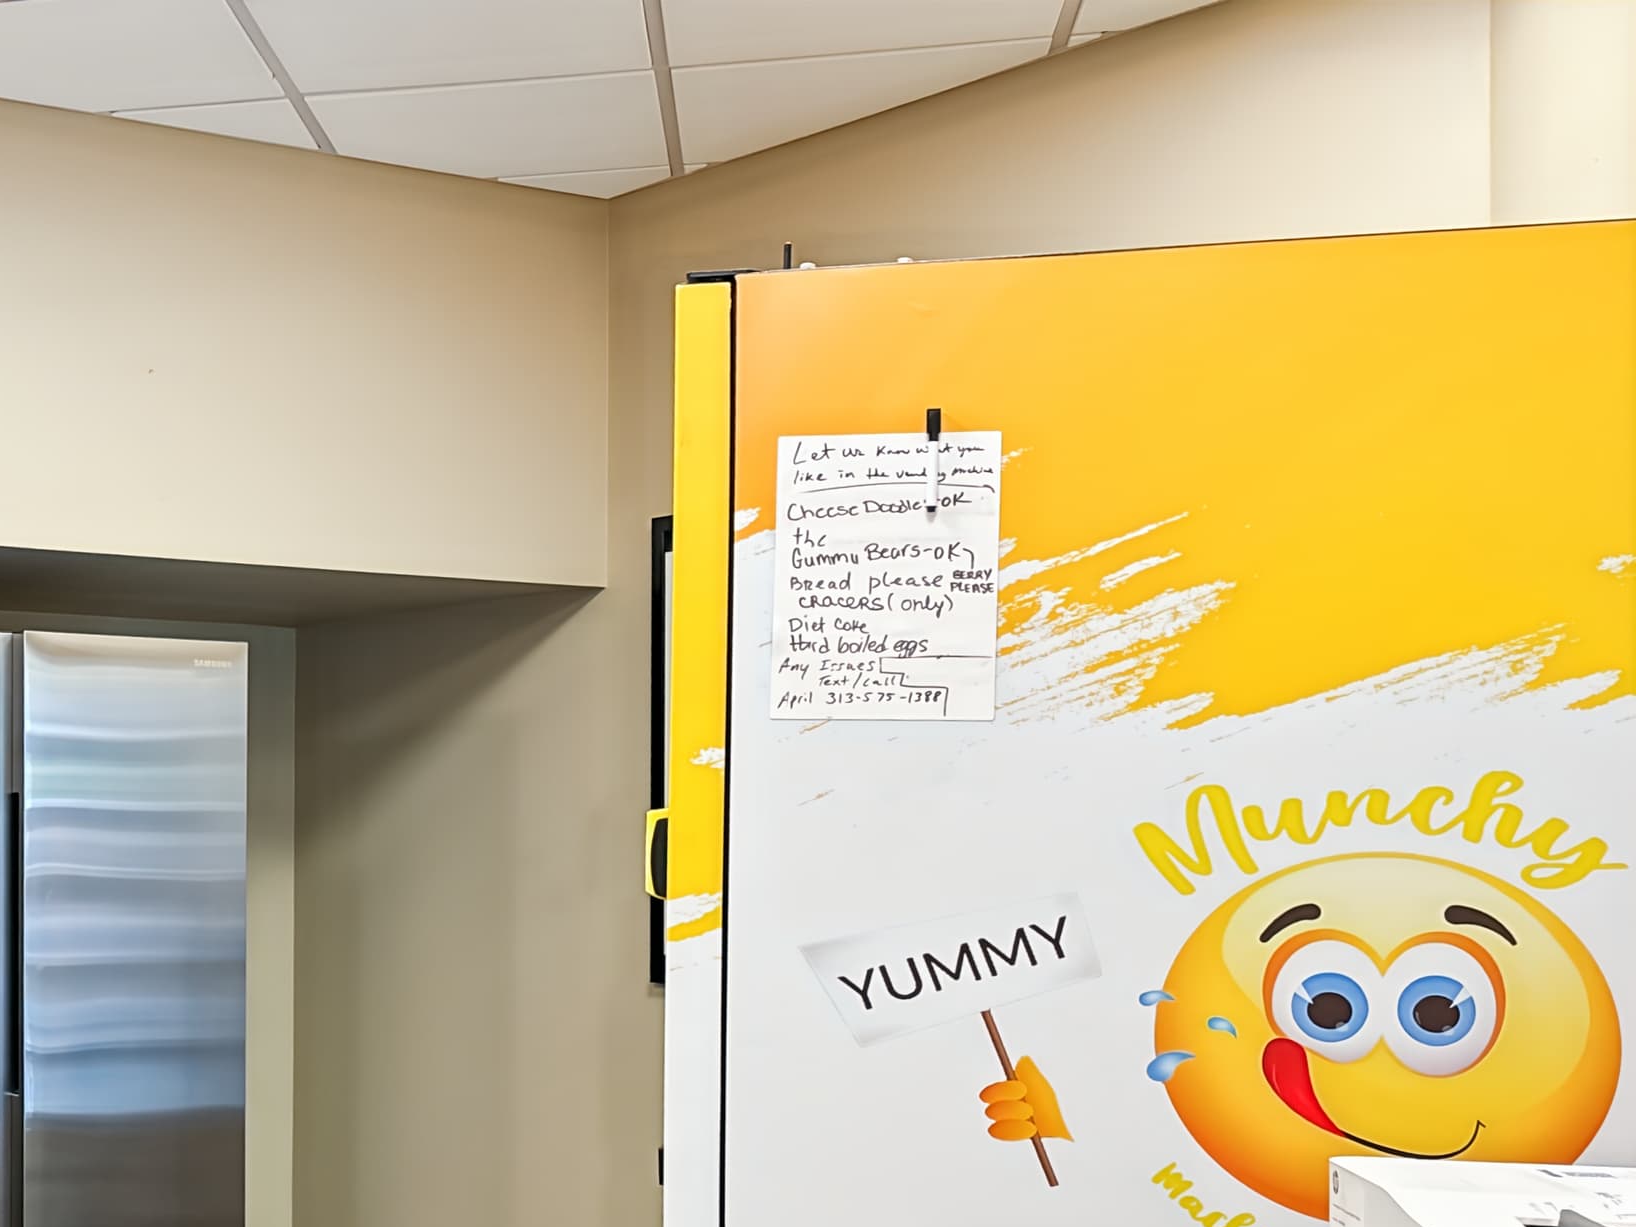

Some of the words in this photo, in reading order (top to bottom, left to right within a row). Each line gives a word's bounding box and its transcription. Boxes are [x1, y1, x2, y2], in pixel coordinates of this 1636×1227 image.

[793, 441, 837, 465] Let
[793, 470, 827, 485] like
[837, 469, 855, 479] in
[866, 467, 890, 480] the
[787, 502, 860, 521] Cheese
[868, 571, 944, 595] please
[950, 581, 995, 594] PLEASE
[788, 614, 826, 633] Diet
[789, 633, 831, 654] Hard
[837, 633, 890, 653] boiled
[892, 639, 929, 659] eggs
[778, 657, 811, 680] Any
[777, 691, 813, 710] April
[1133, 769, 1630, 896] Munchy
[838, 915, 1068, 1011] YUMMY
